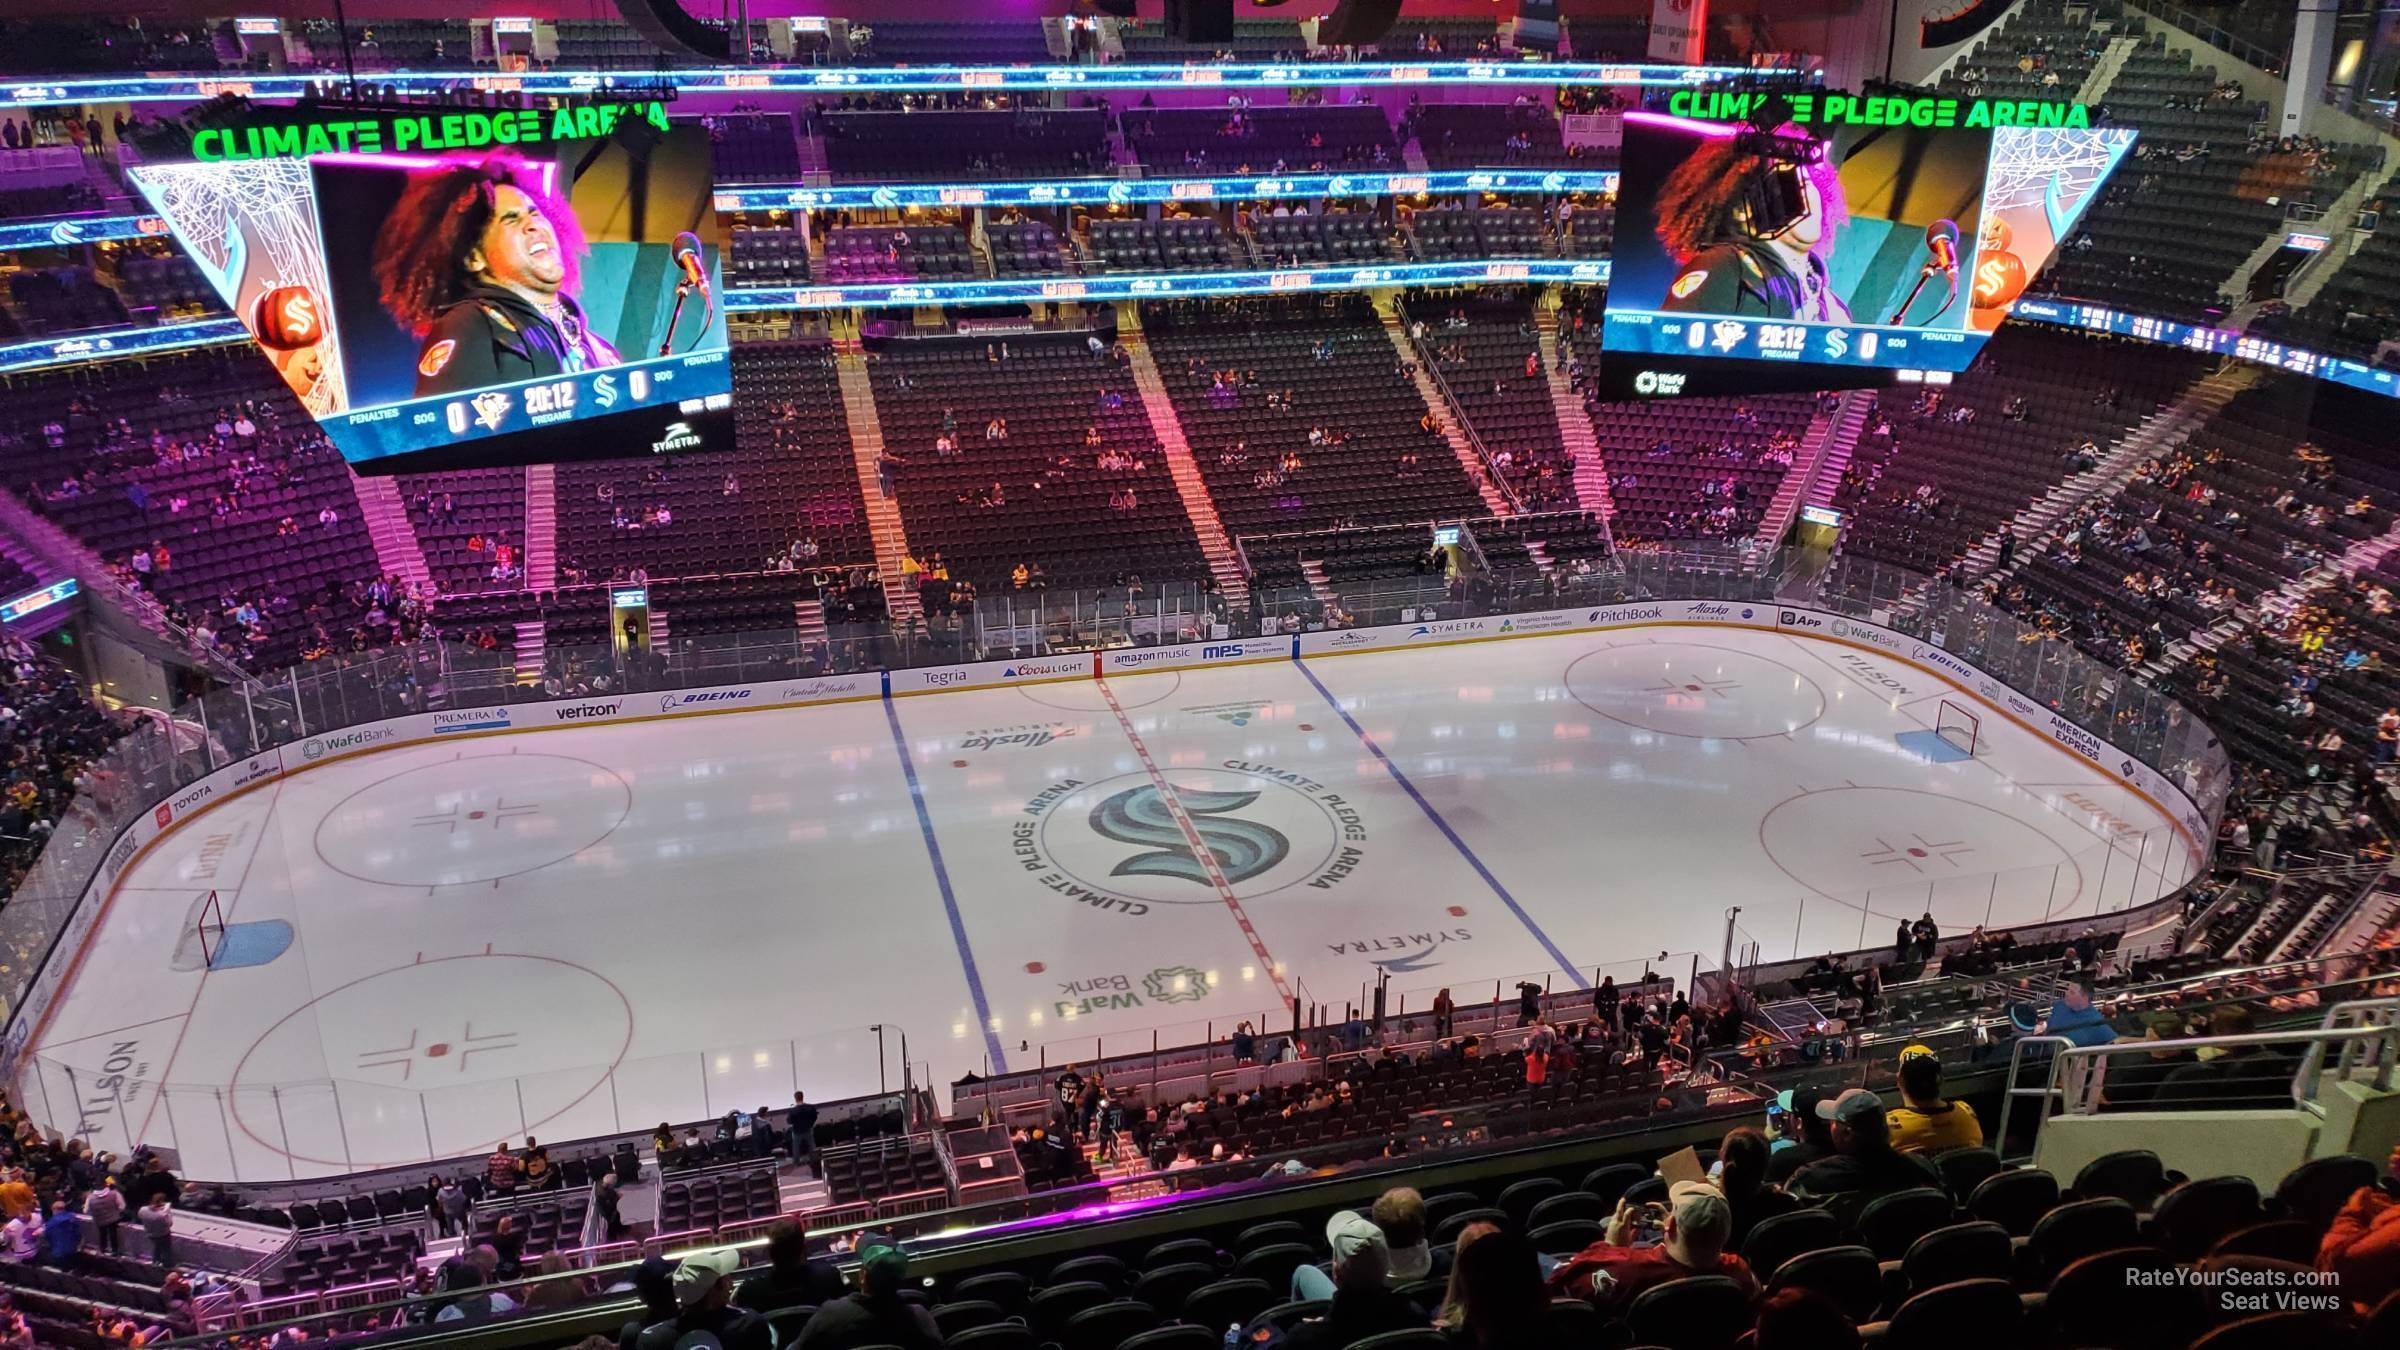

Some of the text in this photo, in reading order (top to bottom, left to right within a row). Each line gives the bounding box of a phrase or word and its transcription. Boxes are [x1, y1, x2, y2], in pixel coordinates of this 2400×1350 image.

[1669, 91, 2089, 129] CLIME PLEDGE ARENA
[192, 101, 670, 163] CLIMATE PLEDGE AREA
[1612, 314, 1652, 324] PENALTIES
[1687, 322, 1706, 348] 0
[1758, 325, 1806, 350] 20:12
[1887, 338, 1907, 348] SOG
[1921, 331, 1965, 343] PENALTIES
[1761, 350, 1800, 360] PREGAME
[1861, 332, 1878, 359] 0
[684, 353, 723, 367] PENALTIES
[629, 371, 647, 401] 0
[654, 370, 673, 382] SOG
[524, 381, 576, 414] 20:12
[350, 408, 399, 425] PENALTIES
[413, 412, 435, 425] SOG
[446, 402, 465, 434] 0
[532, 410, 572, 426] PREGAME
[652, 435, 701, 453] SYMETRA
[1601, 606, 1663, 622] PitchBook
[1687, 602, 1729, 614] Alaska
[1431, 621, 1484, 634] SYMETRA
[1114, 648, 1191, 665] amazon music
[1202, 644, 1244, 660] MPS
[1017, 662, 1083, 676] Coors LIGHT
[1840, 654, 1913, 696] FILSON
[1928, 652, 1972, 678] BOEING
[924, 669, 967, 686] Tegria
[683, 689, 752, 703] BOEING
[2008, 695, 2034, 716] amazon
[434, 711, 490, 725] PREMERA
[556, 702, 617, 720] verizon
[960, 732, 1060, 752] Alaska
[2050, 716, 2101, 750] AMERICAN
[2055, 729, 2100, 761] EXPRESS
[1223, 760, 1325, 793] CLIMATE
[173, 785, 213, 812] TOYOTA
[1320, 794, 1367, 841] PLEDGE
[1013, 779, 1149, 915] CLIMATE PLEDGE ARENA
[1307, 846, 1364, 889] ARENA
[1328, 928, 1472, 955] SYMETRA
[1058, 975, 1131, 997] Bank
[71, 1040, 139, 1138] FILSON
[1061, 1087, 1078, 1103] 87
